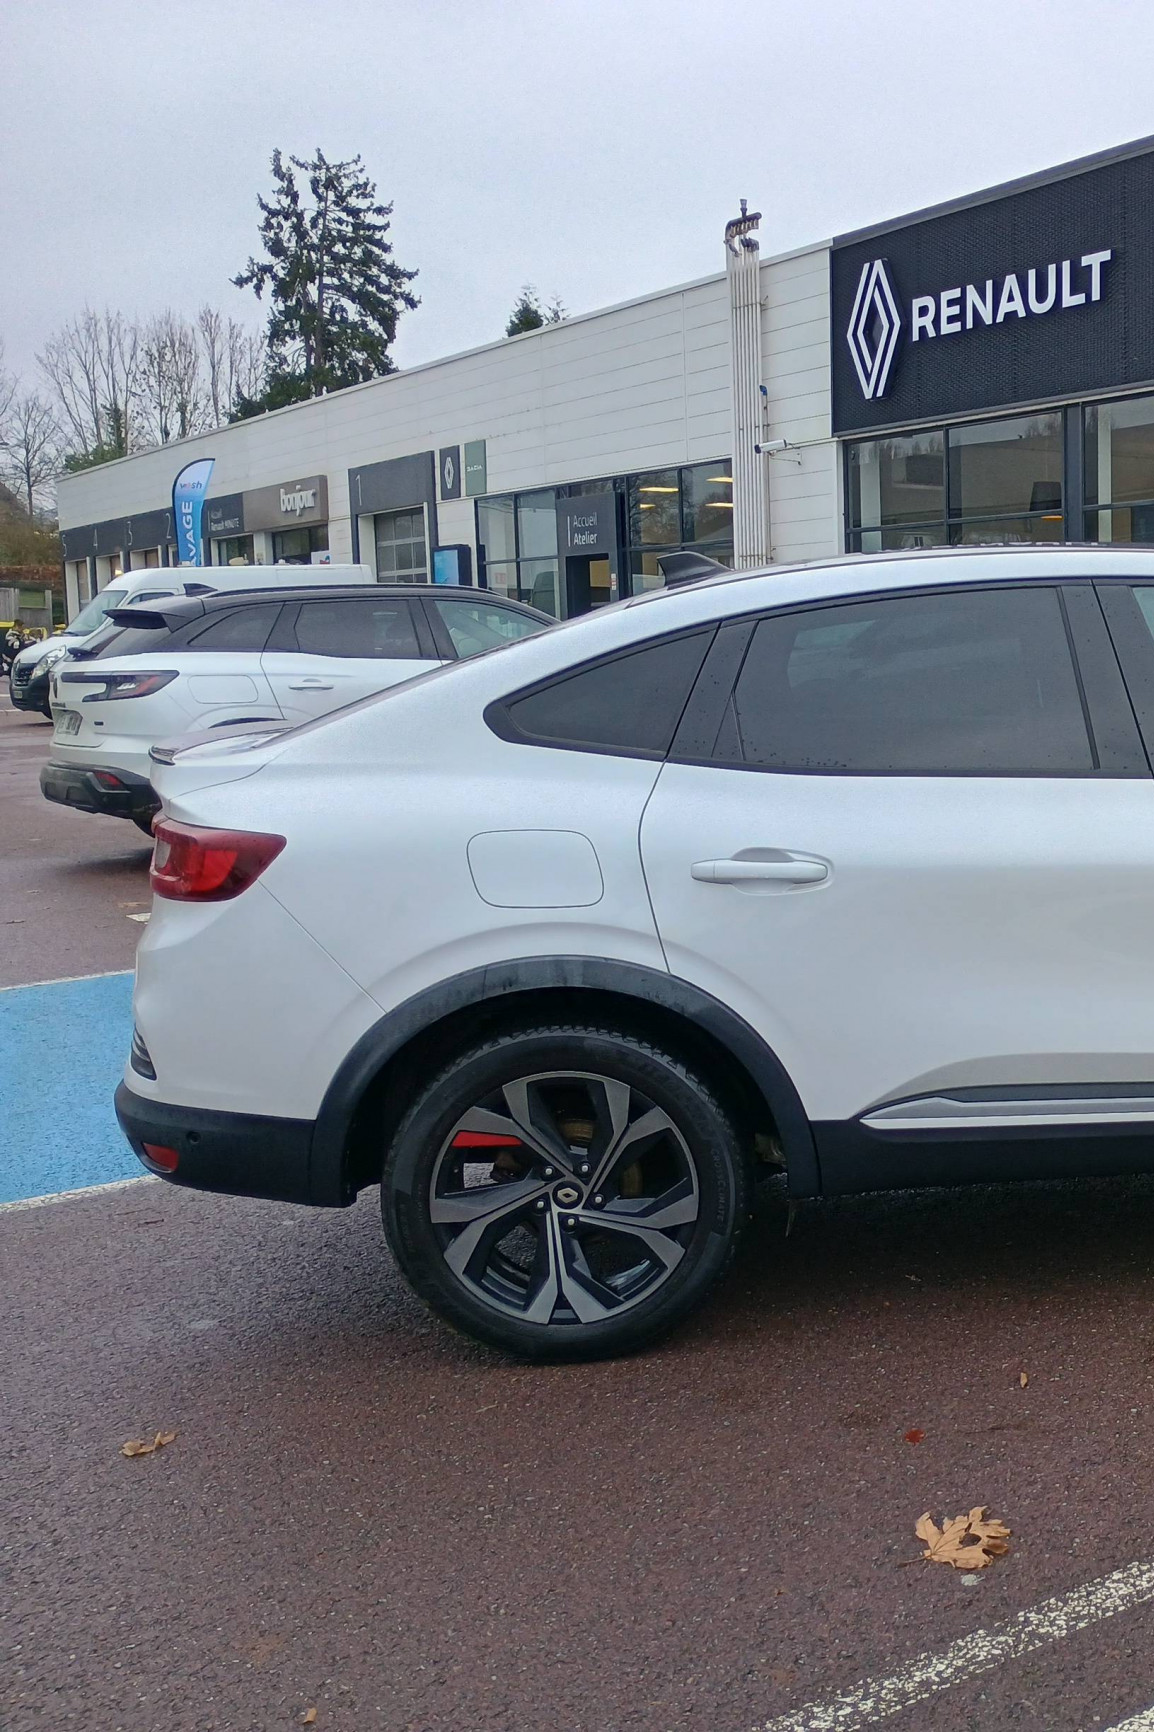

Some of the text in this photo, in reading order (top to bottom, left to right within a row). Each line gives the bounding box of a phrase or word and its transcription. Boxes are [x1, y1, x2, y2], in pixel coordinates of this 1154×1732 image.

[912, 249, 1111, 342] RENAULT
[280, 485, 316, 517] bonjour
[355, 474, 362, 506] 1
[165, 512, 172, 540] 2
[573, 511, 597, 528] Accueil
[573, 530, 598, 546] Atelier
